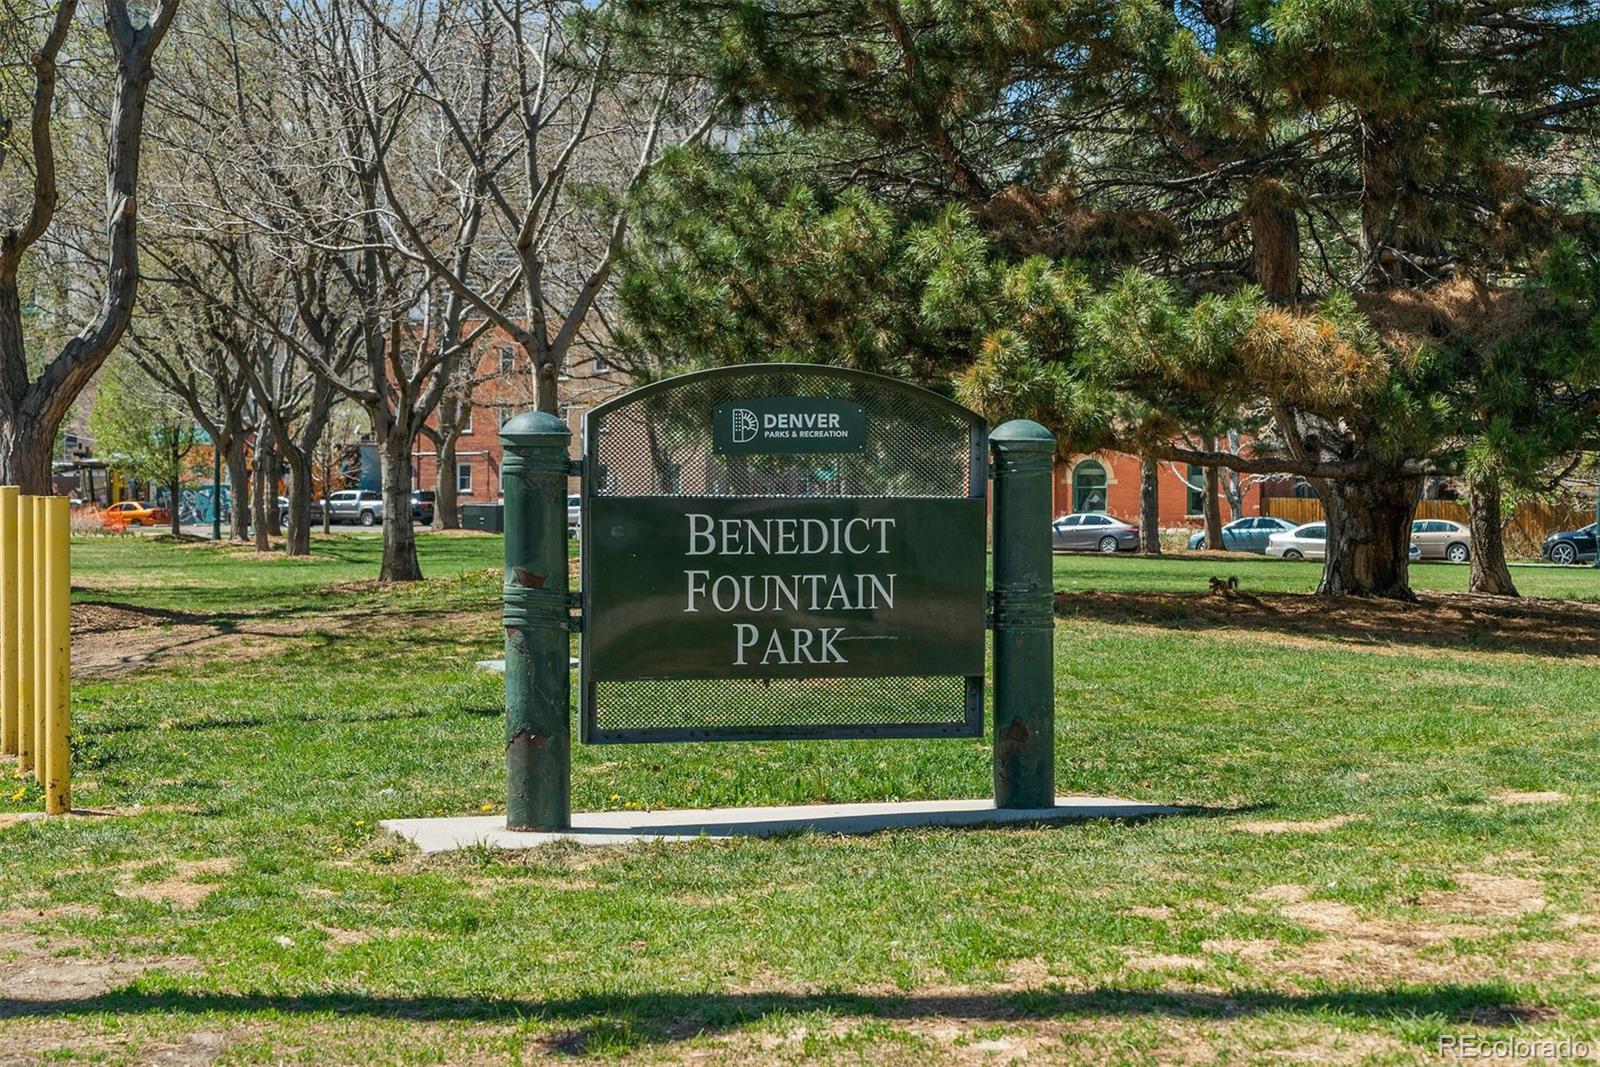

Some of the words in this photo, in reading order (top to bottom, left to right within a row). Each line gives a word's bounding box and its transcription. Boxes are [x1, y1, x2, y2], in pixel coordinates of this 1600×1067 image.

[764, 413, 840, 429] DENVER
[764, 430, 790, 438] PARKS
[791, 430, 798, 438] &
[799, 430, 849, 438] RECREATION
[684, 513, 896, 556] BENEDICT
[683, 569, 898, 613] FOUNTAIN
[732, 623, 849, 666] PARK
